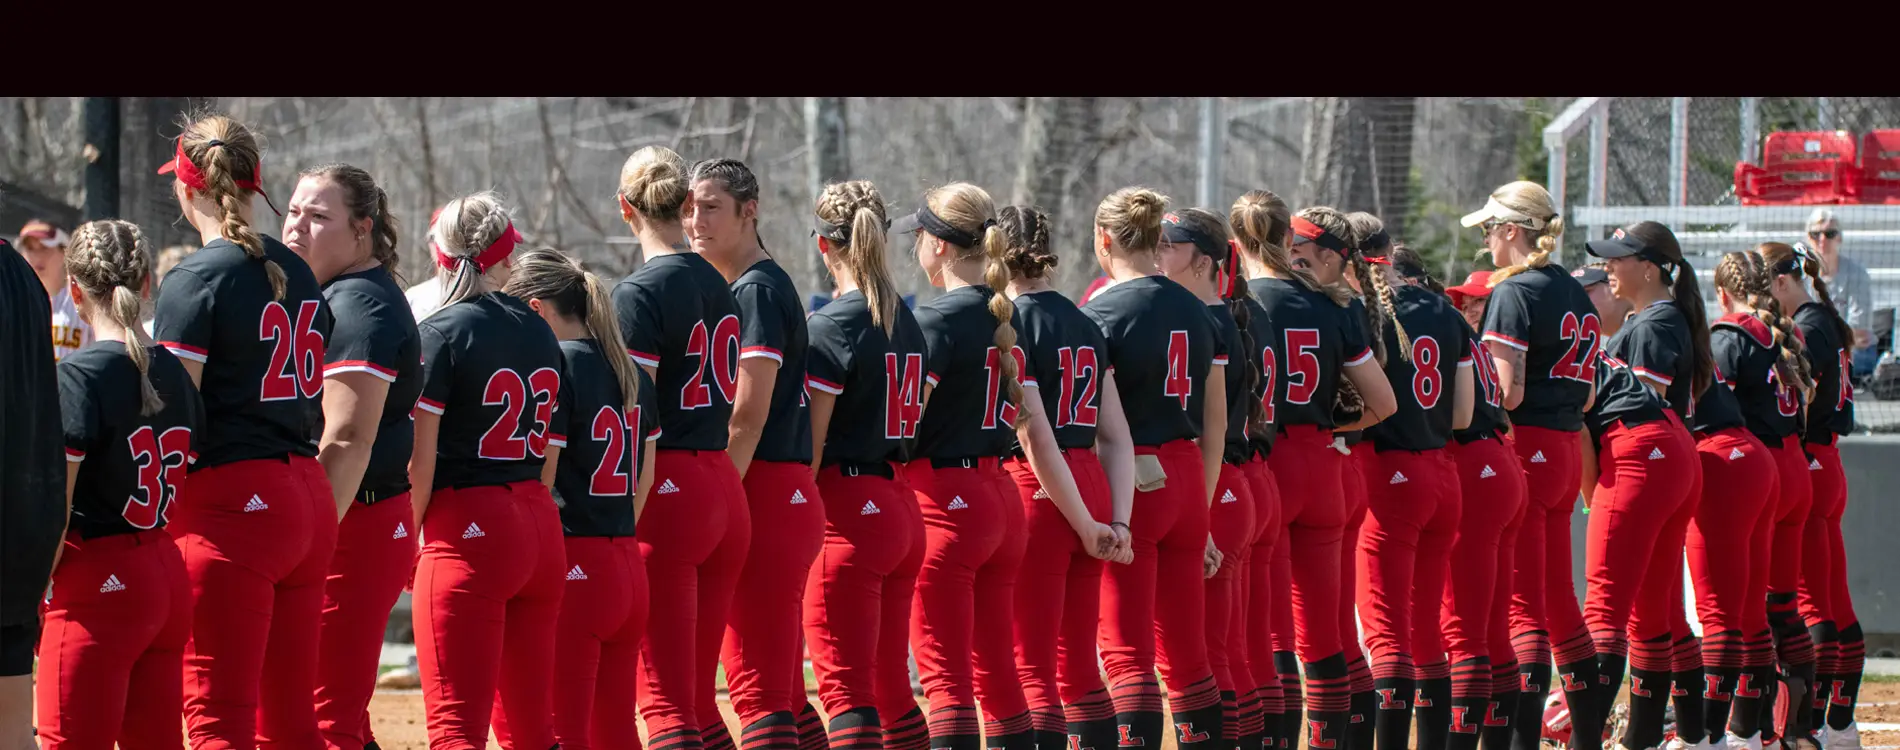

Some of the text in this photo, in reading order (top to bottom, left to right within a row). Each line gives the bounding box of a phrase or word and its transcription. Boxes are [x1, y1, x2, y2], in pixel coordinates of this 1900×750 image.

[259, 300, 324, 402] 26
[680, 314, 741, 410] 20
[1164, 330, 1192, 411] 4
[1284, 328, 1320, 405] 5
[1412, 335, 1443, 409] 8
[1549, 311, 1600, 384] 22
[885, 353, 923, 439] 14
[1056, 346, 1099, 428] 12
[478, 367, 560, 460] 23
[589, 405, 641, 496] 21
[122, 425, 191, 530] 33
[99, 583, 126, 593] adidas
[1376, 688, 1406, 709] L
[1560, 672, 1587, 692] L
[1631, 674, 1651, 698] L
[1704, 674, 1731, 700] L
[1735, 673, 1761, 697] L
[1831, 680, 1851, 706] L
[1118, 724, 1144, 747] L
[1175, 722, 1210, 743] L
[1307, 719, 1336, 749] L
[1449, 706, 1477, 734] L
